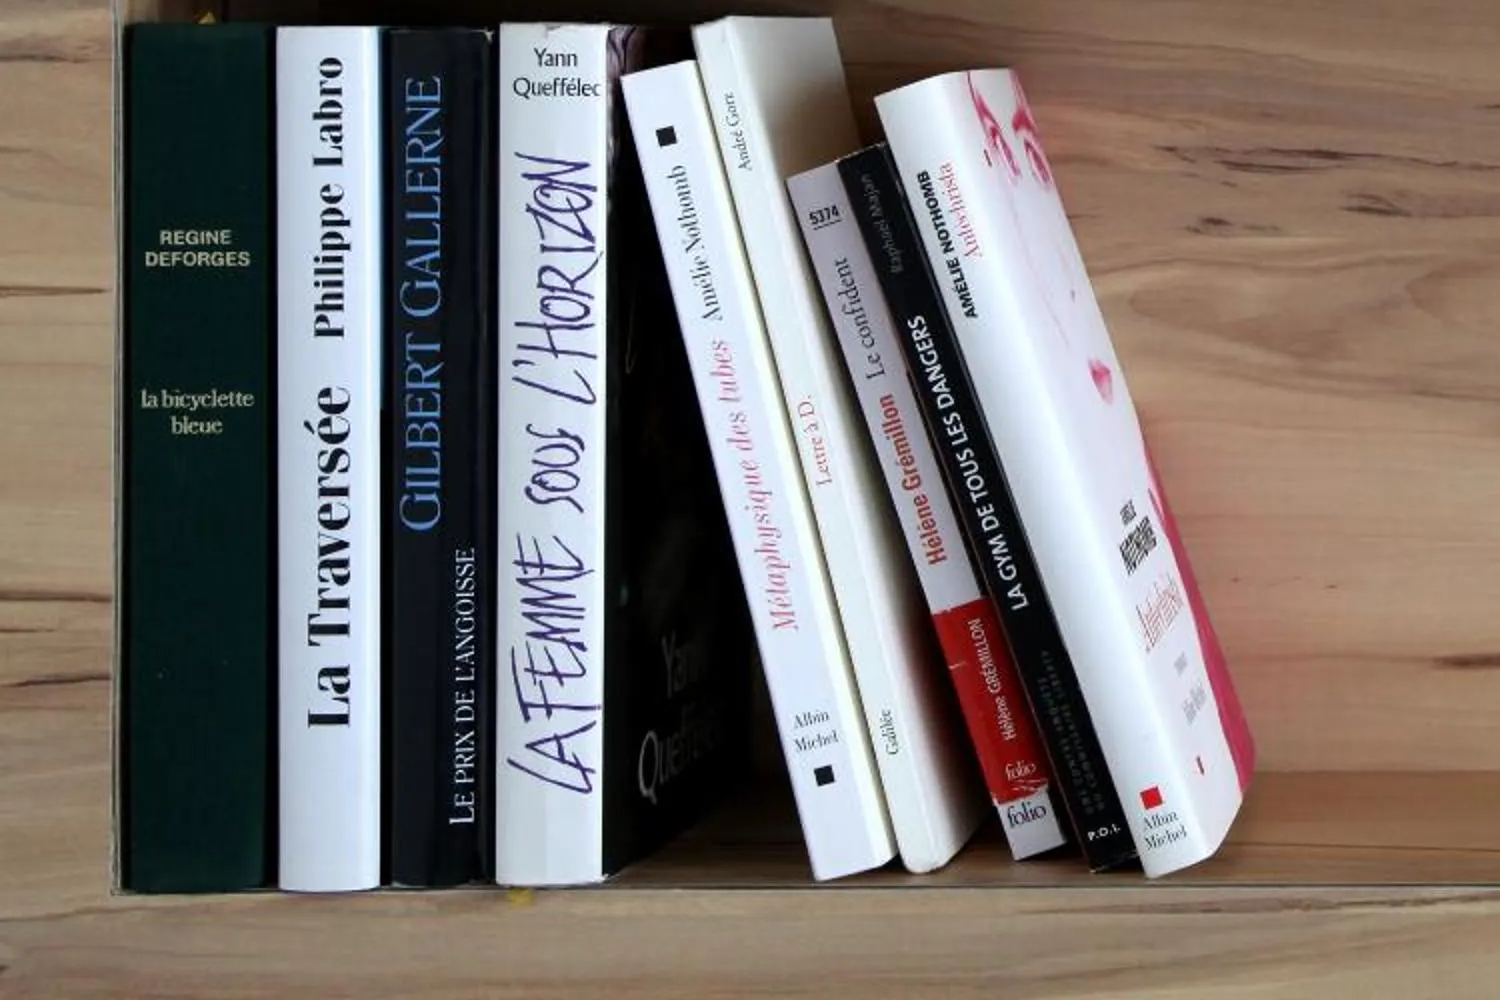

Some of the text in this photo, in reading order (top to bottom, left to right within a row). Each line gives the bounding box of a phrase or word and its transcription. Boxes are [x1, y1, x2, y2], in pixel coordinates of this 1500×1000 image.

[533, 47, 578, 69] Yann
[512, 76, 601, 100] Queffélec
[733, 127, 752, 172] André
[313, 56, 352, 338] Philippe Labro
[917, 170, 955, 254] NOTHOMB
[808, 204, 840, 226] 5374
[159, 229, 232, 246] REGINE
[666, 164, 724, 321] Amélie Nothomb
[144, 251, 251, 268] DEFORGES
[400, 75, 442, 533] GILBERT GALLERNE
[834, 256, 887, 380] Le confident
[140, 389, 255, 414] la bicyclette
[171, 416, 223, 435] bleue
[507, 152, 603, 794] LA FEMME SOUS L'HORIZON
[880, 393, 948, 566] Hélène Grémillon
[908, 315, 1030, 611] LA GYM DE TOUS LES DANGERS
[710, 339, 799, 631] Métaphysique des tubes
[303, 385, 351, 729] La Traversée
[449, 548, 475, 825] LE PRIX DE L'ANGOISSE
[794, 709, 830, 729] Albin
[880, 708, 899, 755] Galilée
[794, 729, 839, 753] Michel
[1005, 760, 1037, 781] folio
[1007, 803, 1048, 829] folio
[1142, 809, 1180, 833] Albin
[1143, 825, 1188, 851] Michel
